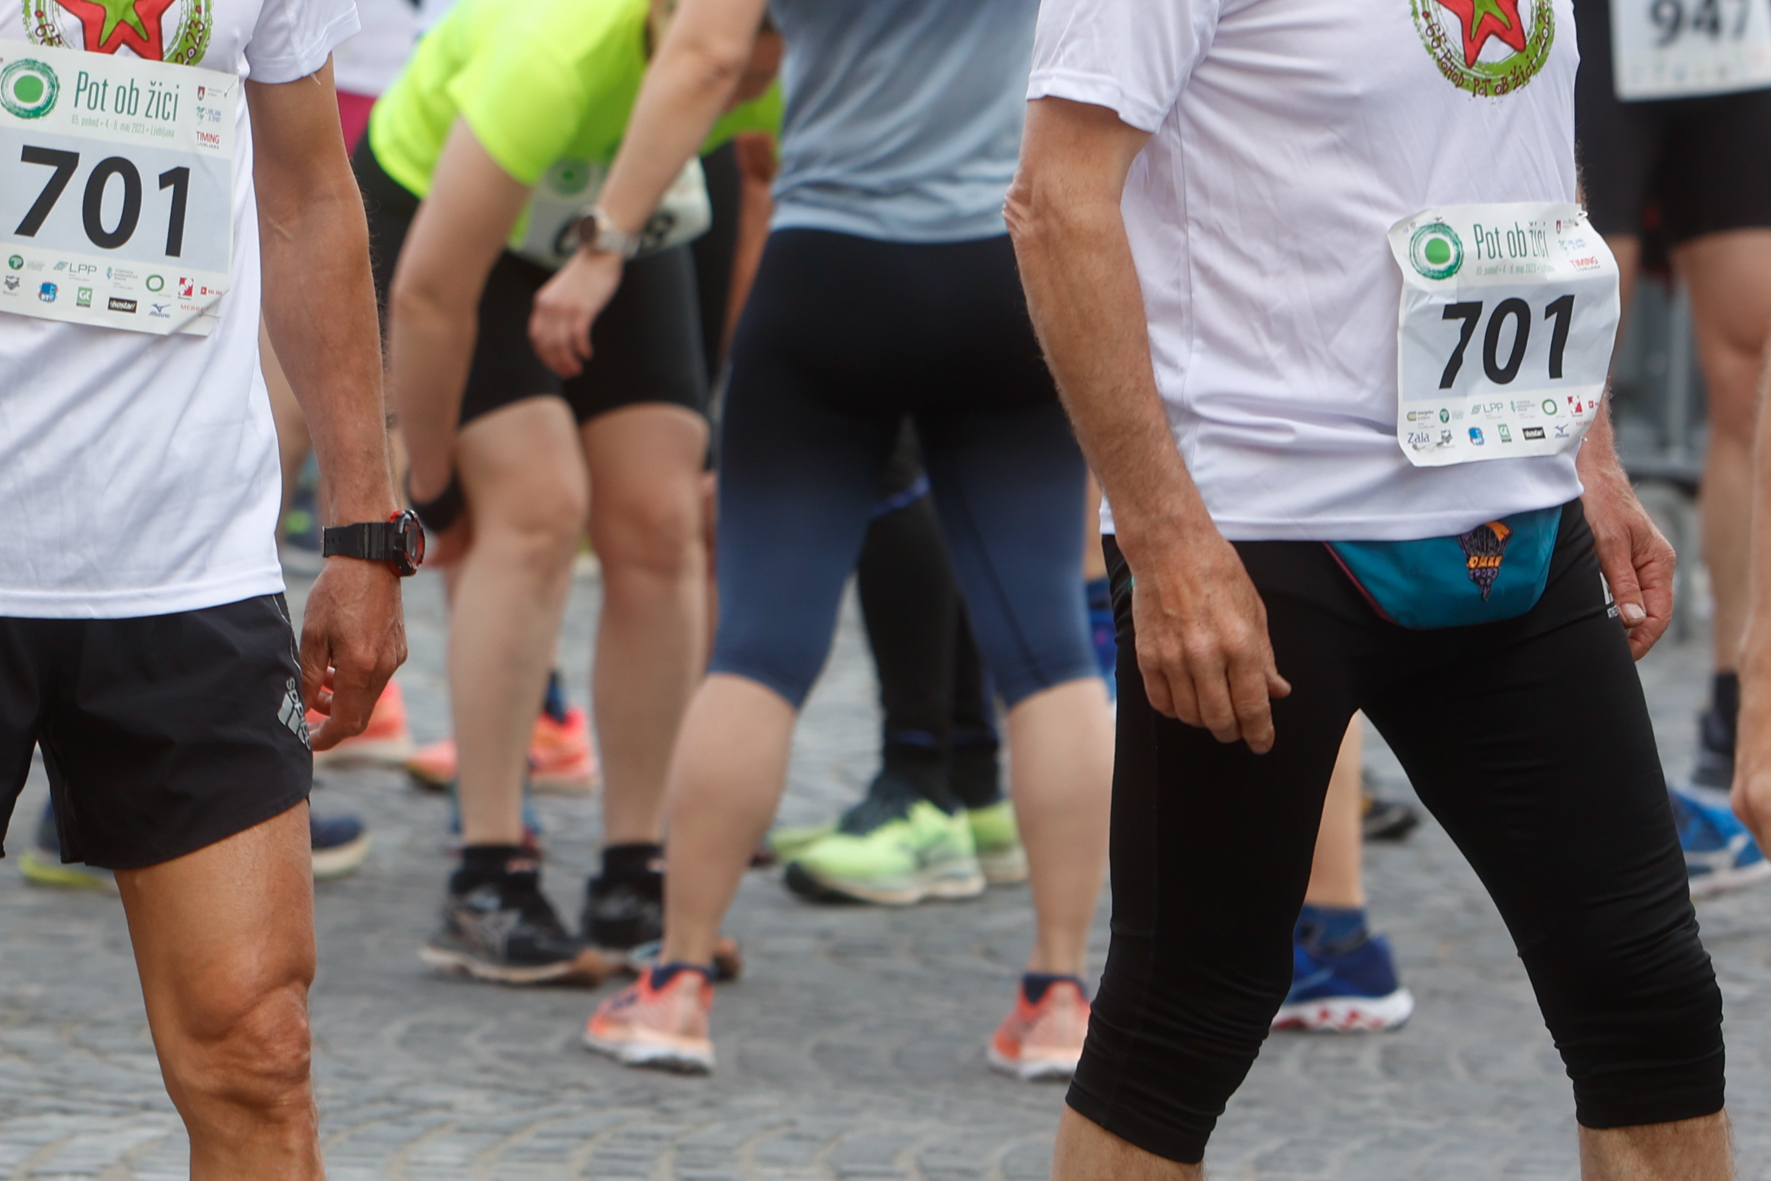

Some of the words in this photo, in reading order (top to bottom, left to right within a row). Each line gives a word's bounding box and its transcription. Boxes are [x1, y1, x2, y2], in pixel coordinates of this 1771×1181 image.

[74, 70, 109, 112] Pot
[114, 78, 140, 117] ob
[144, 80, 180, 122] žici
[131, 122, 145, 135] 2023
[196, 130, 220, 144] TIMING
[13, 144, 190, 258] 701
[1473, 223, 1503, 260] Pot
[1506, 221, 1527, 258] ob
[1529, 221, 1549, 258] žici
[69, 262, 97, 275] LPP
[1569, 256, 1599, 268] TIMING
[1438, 294, 1575, 390] 701
[1483, 402, 1503, 414] LPP
[1407, 431, 1430, 444] Zala
